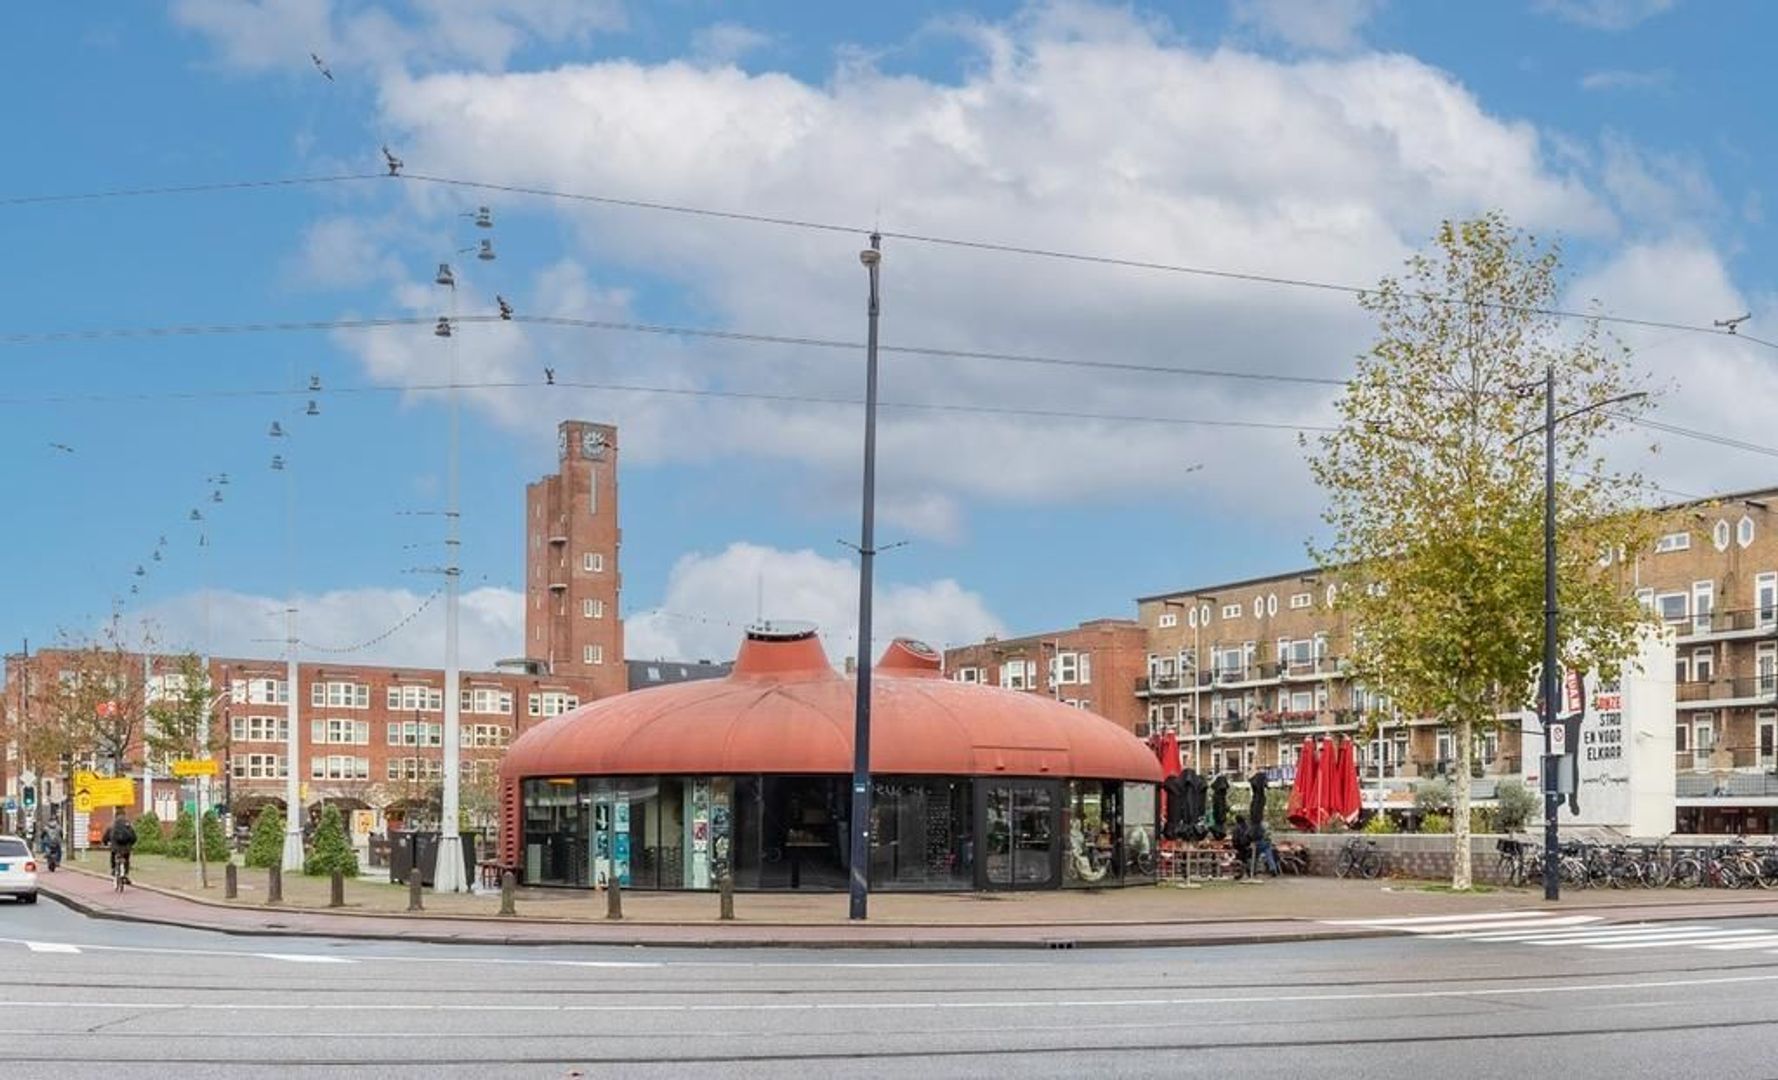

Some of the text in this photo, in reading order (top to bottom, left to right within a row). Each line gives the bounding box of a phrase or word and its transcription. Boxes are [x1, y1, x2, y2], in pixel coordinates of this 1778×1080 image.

[1584, 730, 1622, 744] EN VOOR
[1587, 747, 1622, 761] ELKAAR
